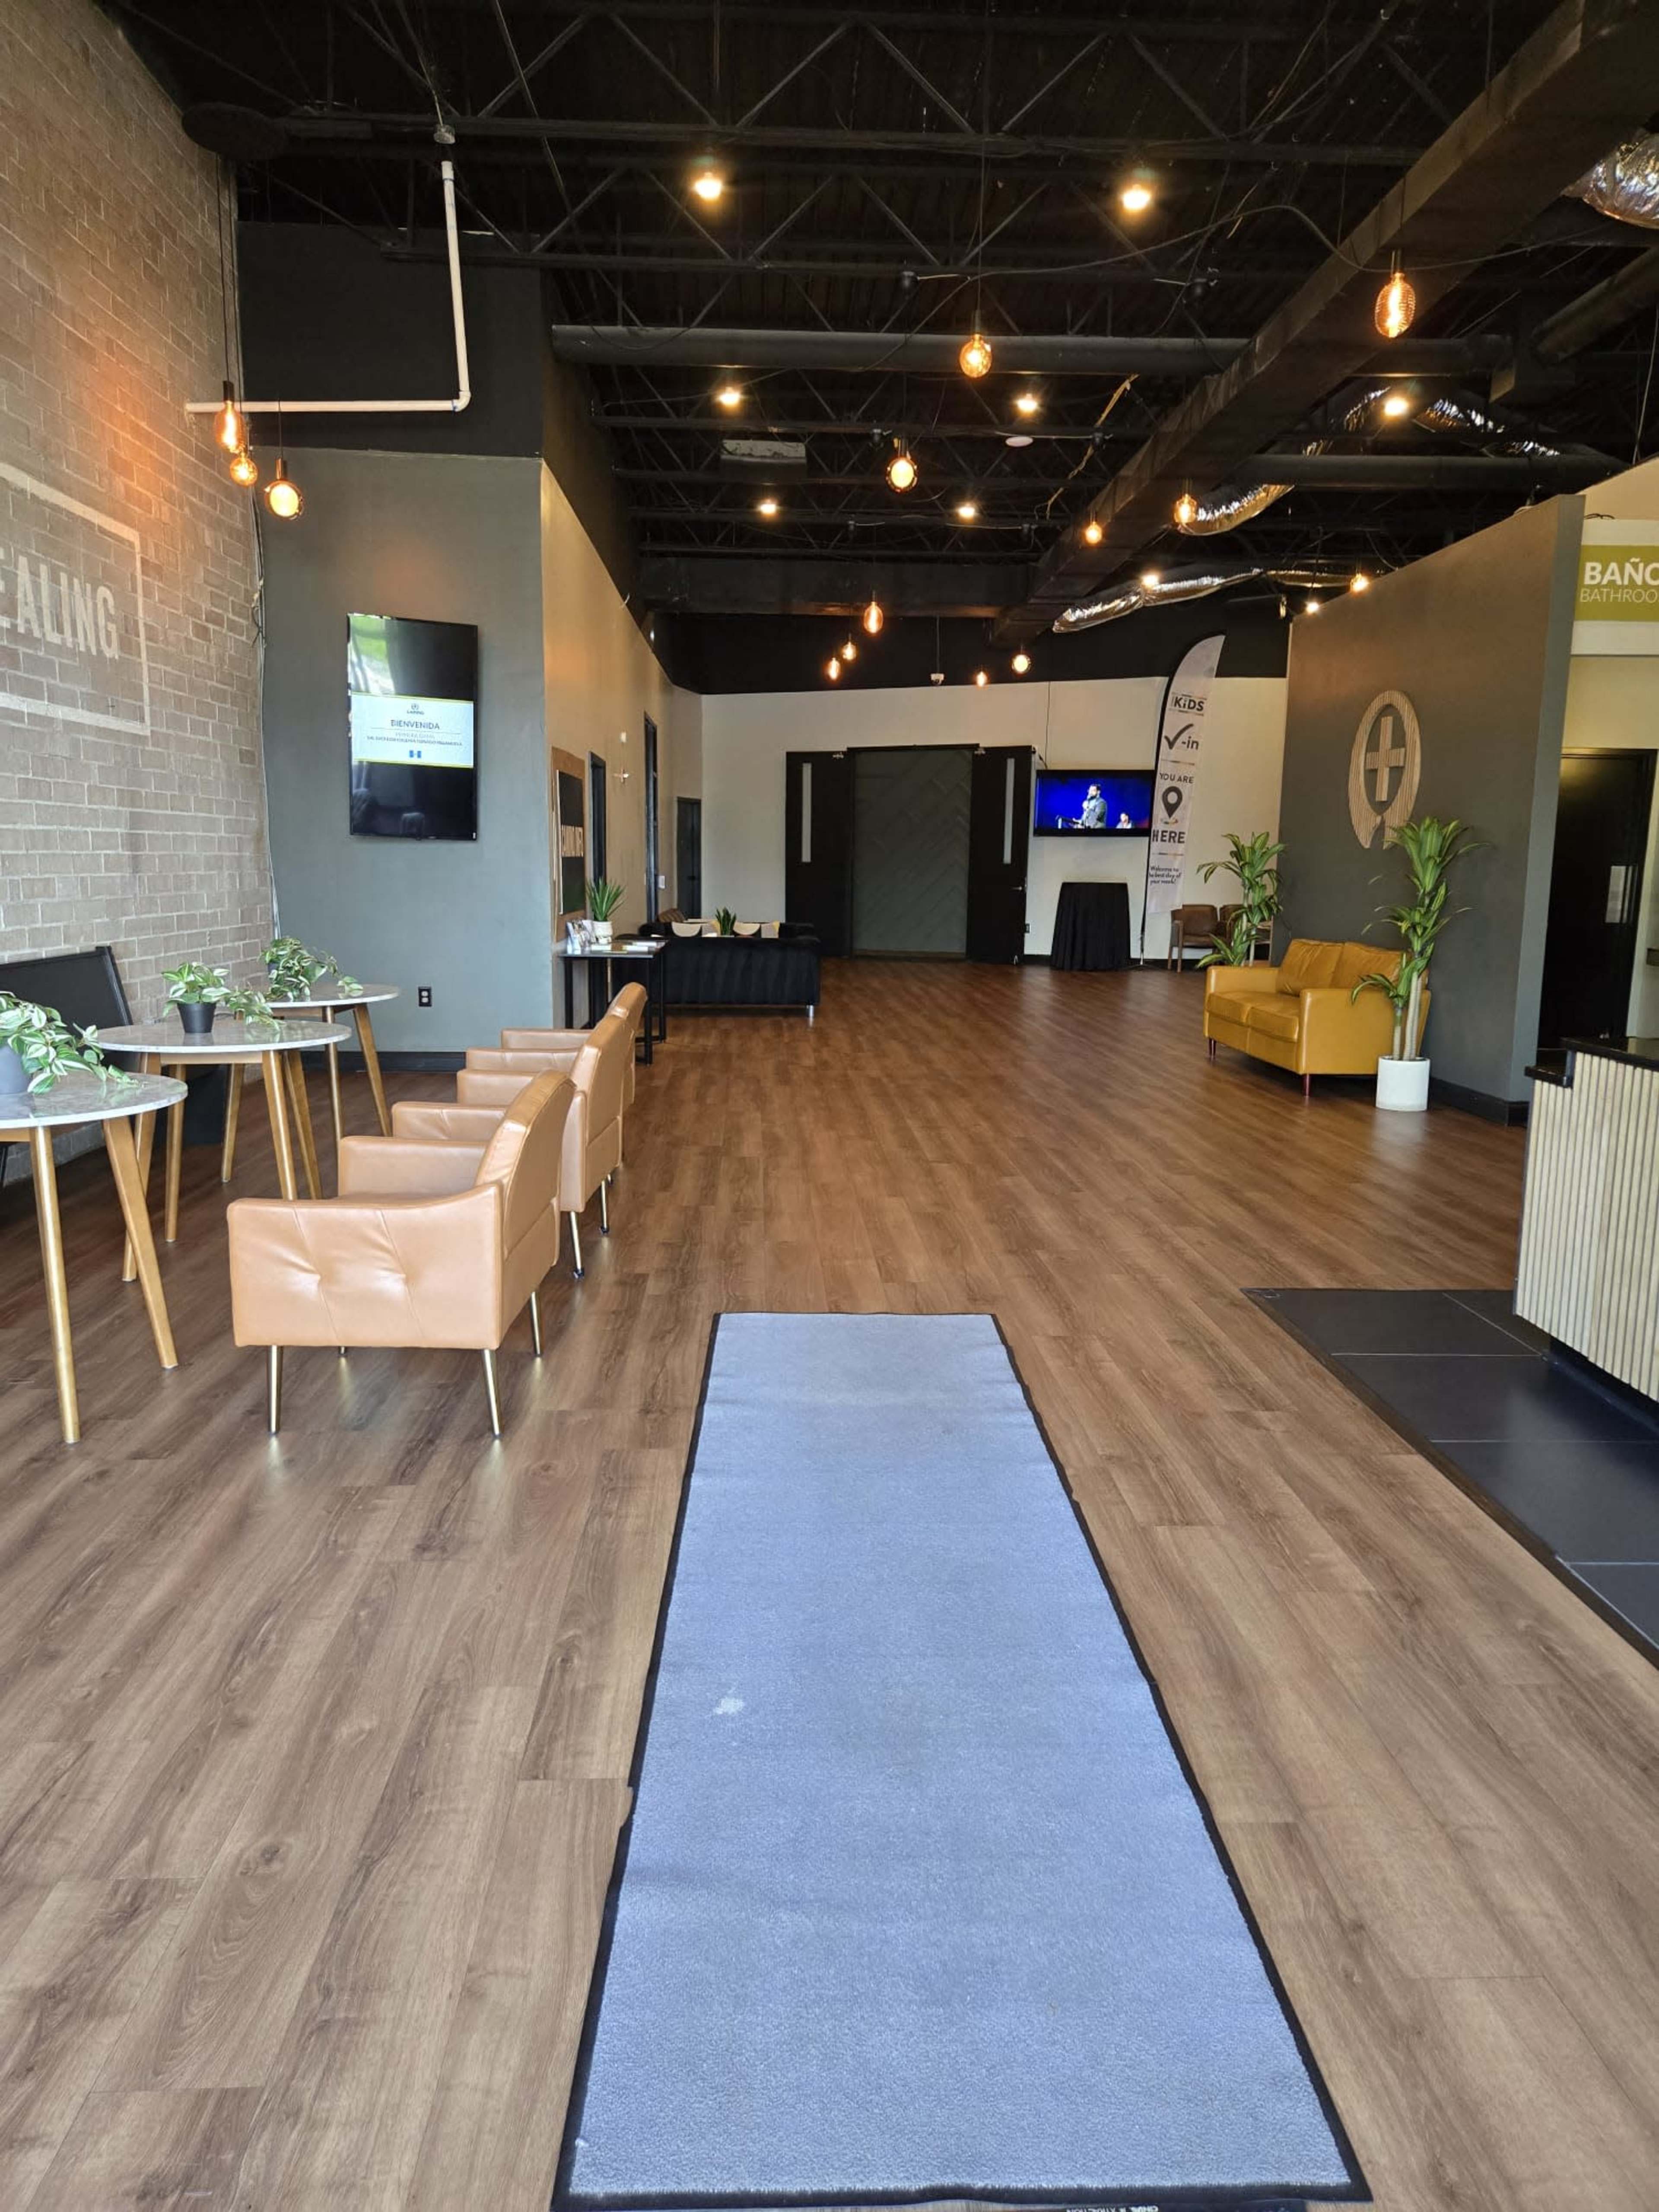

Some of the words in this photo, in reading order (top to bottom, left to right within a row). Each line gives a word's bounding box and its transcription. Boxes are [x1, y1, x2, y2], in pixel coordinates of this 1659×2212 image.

[1580, 588, 1659, 603] BATHROO
[391, 719, 440, 730] BIENVENIDA
[1160, 772, 1176, 781] YOU
[1177, 775, 1194, 784] ARE
[1152, 830, 1185, 843] HERE
